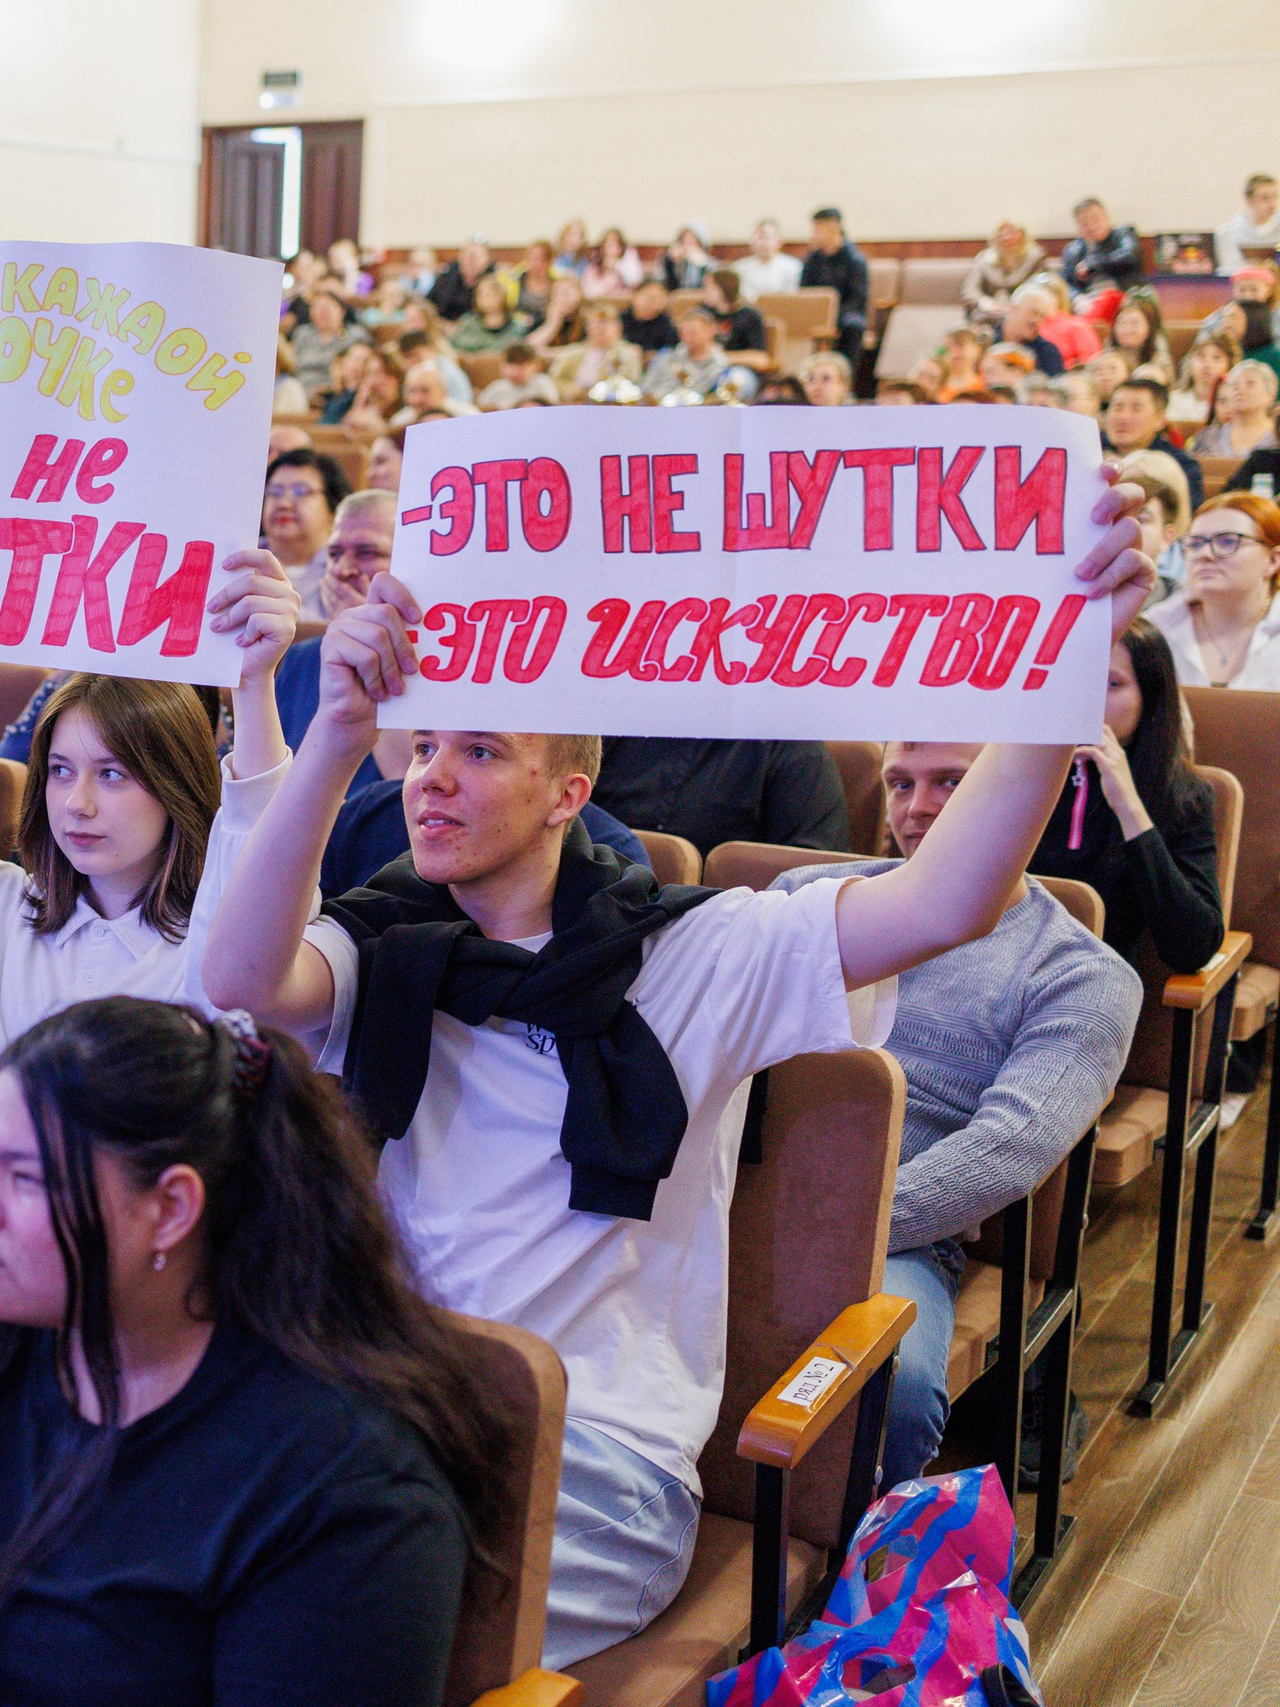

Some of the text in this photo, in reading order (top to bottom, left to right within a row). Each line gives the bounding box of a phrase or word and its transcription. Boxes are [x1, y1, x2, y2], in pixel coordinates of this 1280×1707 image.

[599, 453, 701, 555] НЕ
[722, 445, 1068, 556] ШУТКИ
[581, 592, 1089, 692] ИСКУССТВО!
